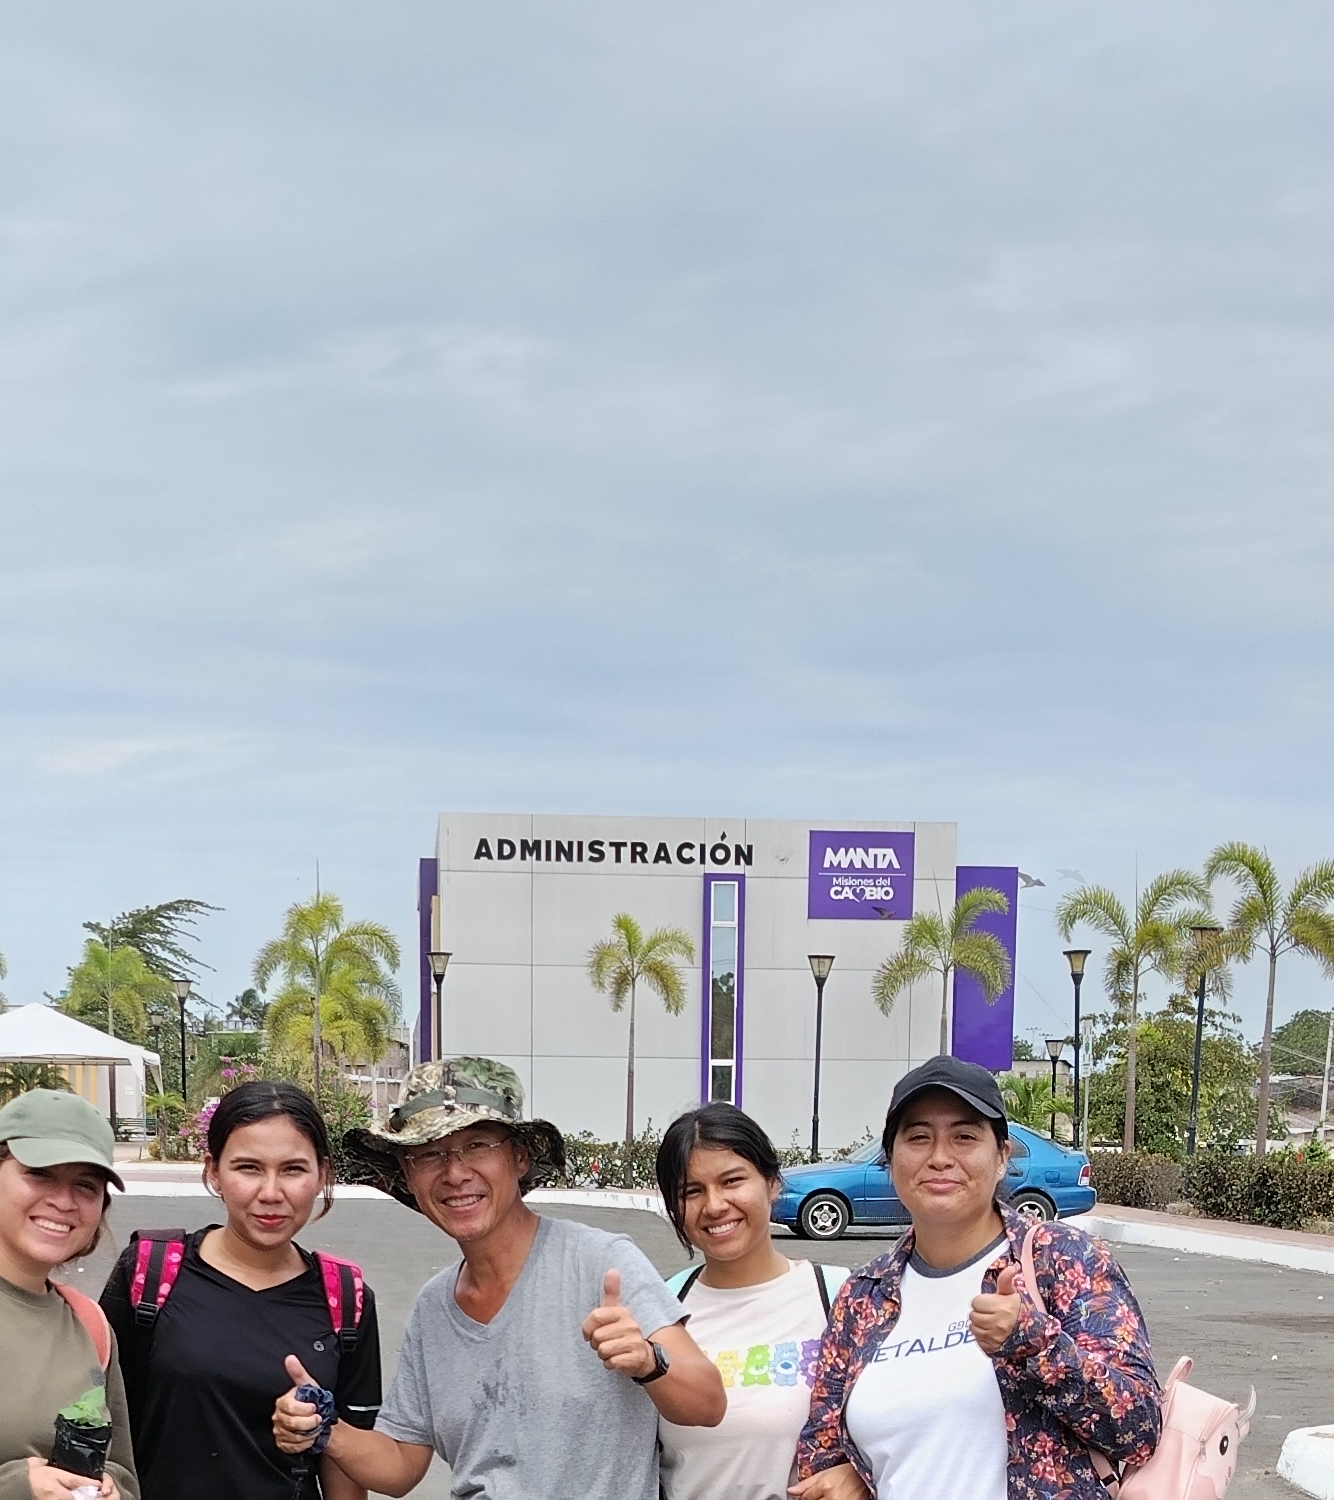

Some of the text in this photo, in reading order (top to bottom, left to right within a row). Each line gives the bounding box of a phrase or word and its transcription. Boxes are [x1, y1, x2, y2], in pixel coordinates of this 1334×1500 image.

[474, 831, 753, 866] ADMINISTRACIÓN
[823, 847, 901, 869] MANTA
[832, 876, 891, 886] Misiones del
